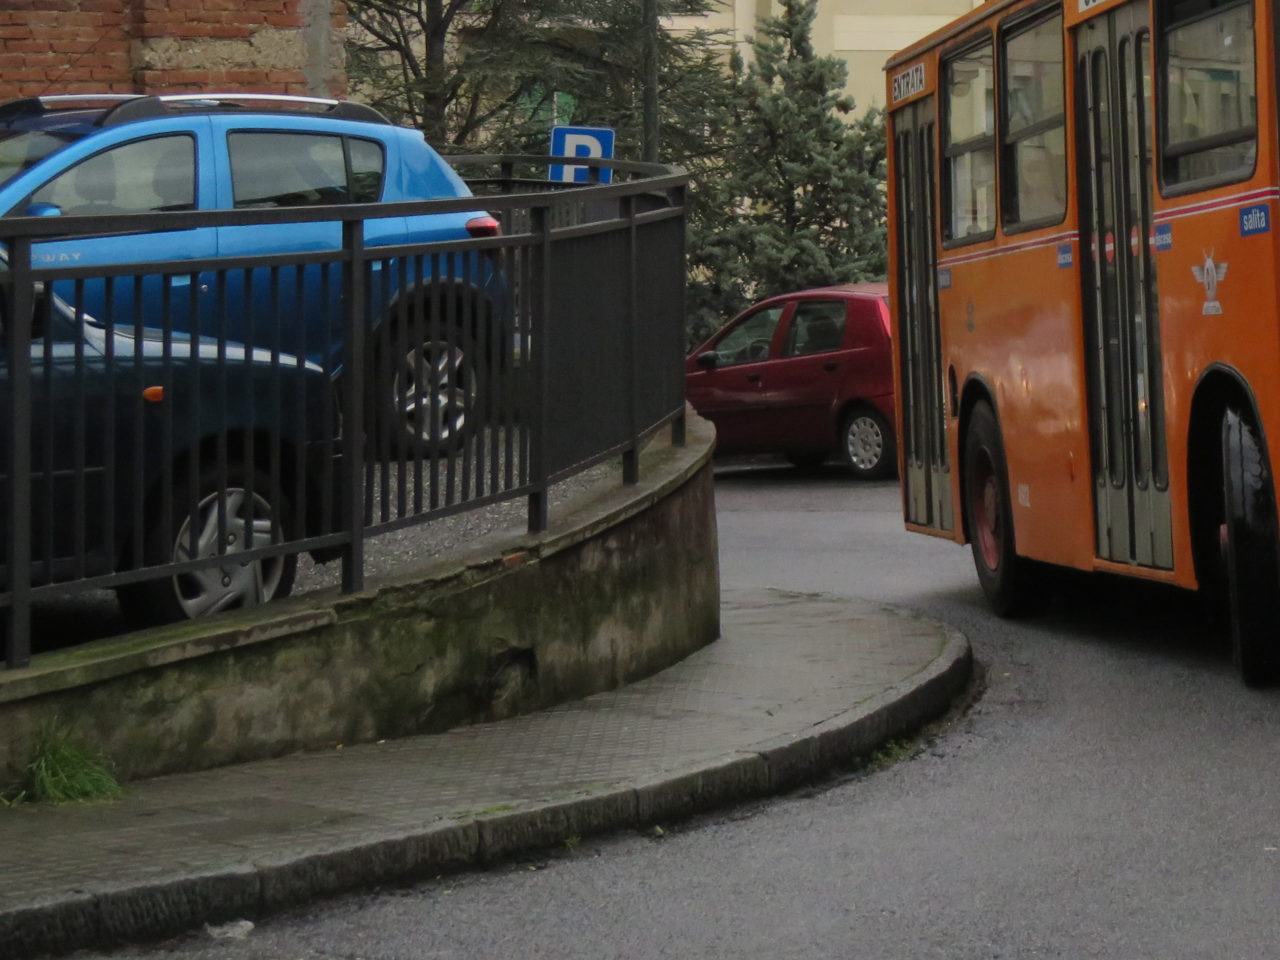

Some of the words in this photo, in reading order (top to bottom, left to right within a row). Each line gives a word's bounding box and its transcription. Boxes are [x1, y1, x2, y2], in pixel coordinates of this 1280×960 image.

[893, 64, 925, 103] ENTRATA
[562, 133, 603, 182] P
[1243, 208, 1266, 231] salita
